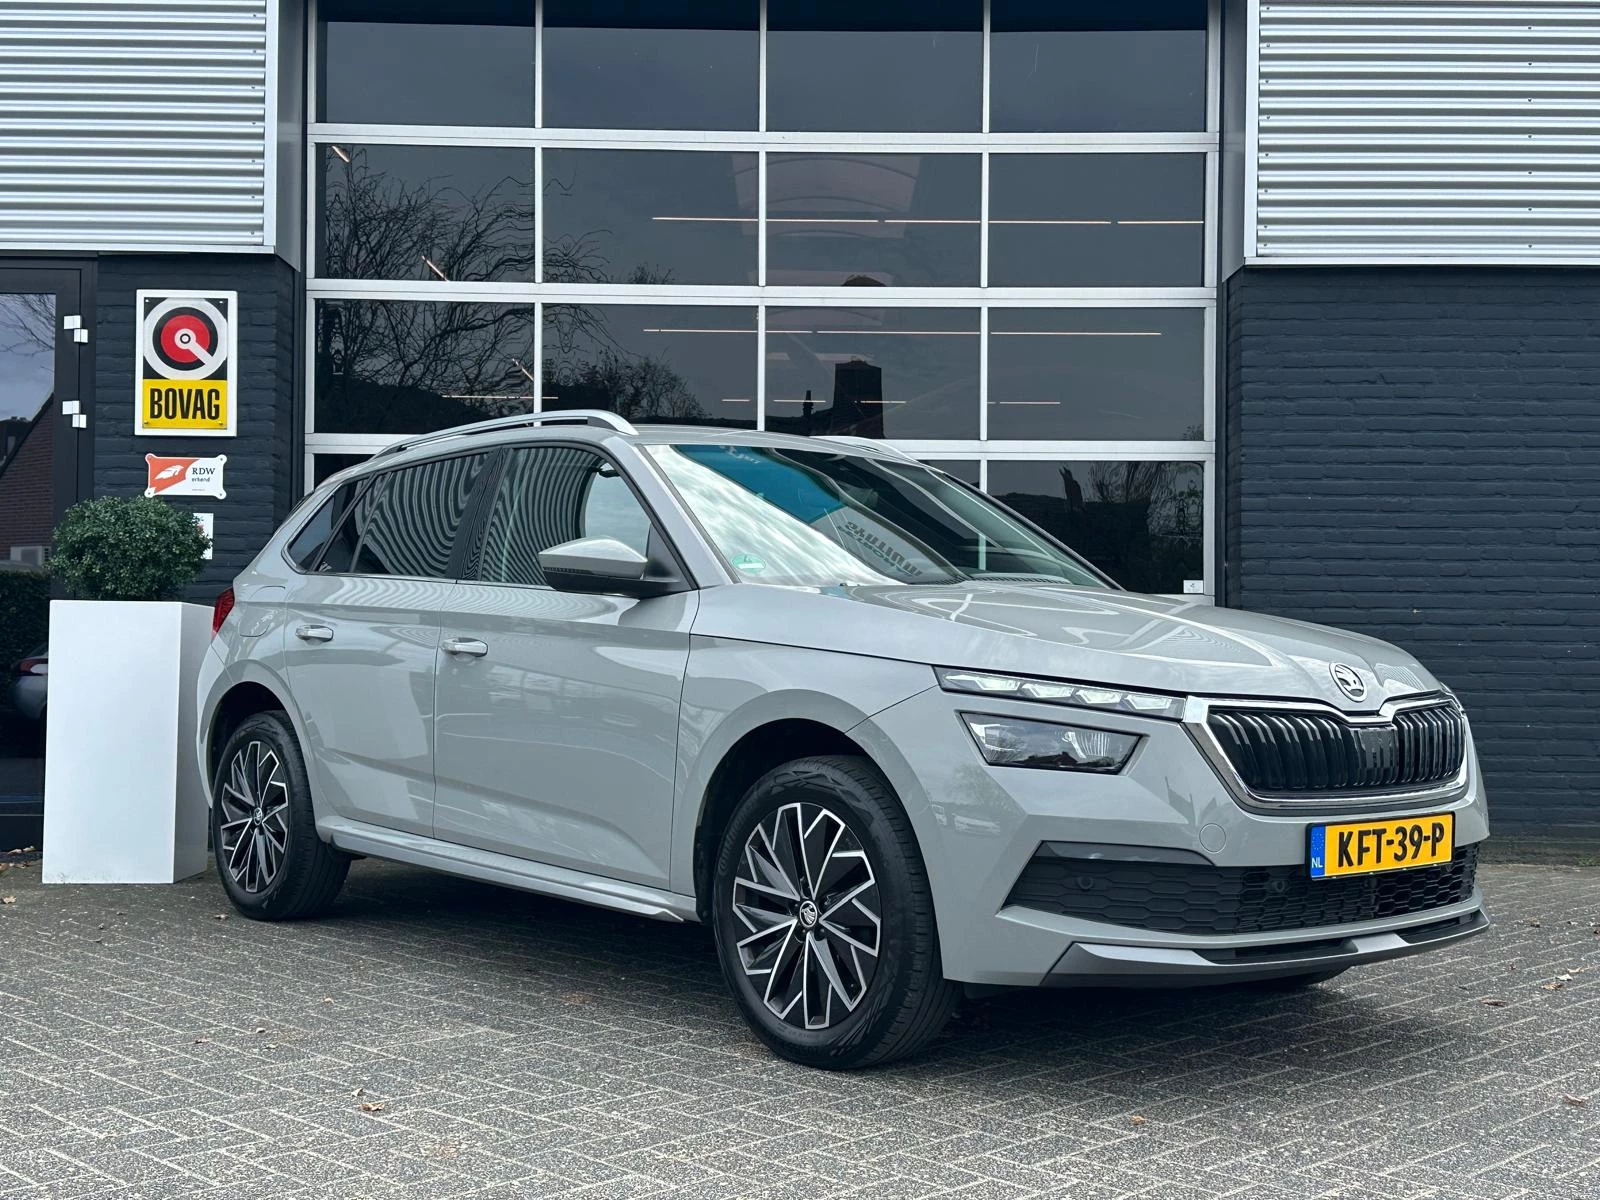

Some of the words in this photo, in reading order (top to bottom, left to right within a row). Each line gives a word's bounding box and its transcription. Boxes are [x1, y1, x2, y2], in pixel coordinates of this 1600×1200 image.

[150, 388, 220, 420] BOVAG
[192, 467, 215, 475] RDW
[1338, 822, 1445, 867] KFT-39-P
[1311, 857, 1324, 868] NL
